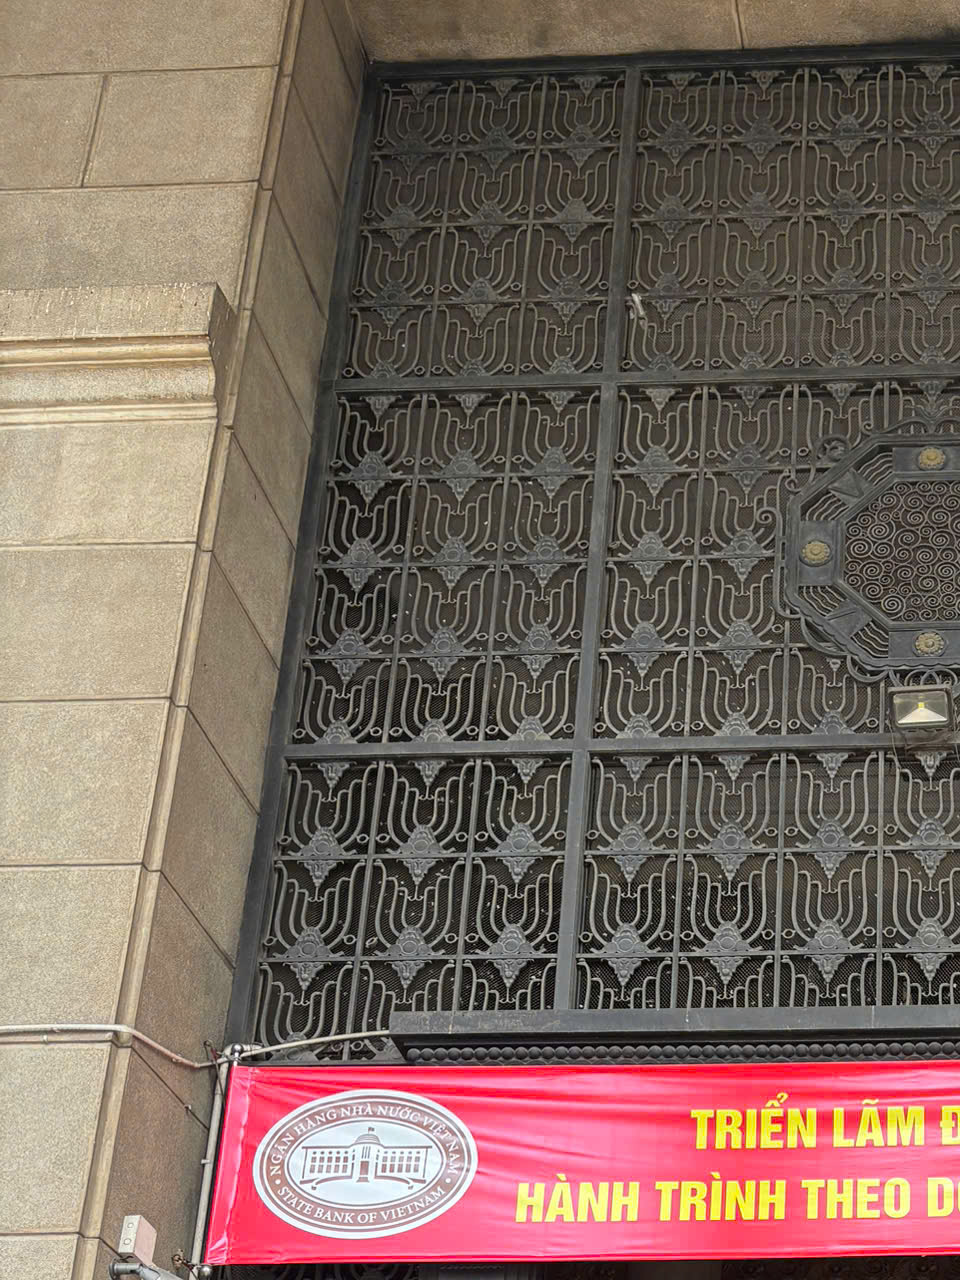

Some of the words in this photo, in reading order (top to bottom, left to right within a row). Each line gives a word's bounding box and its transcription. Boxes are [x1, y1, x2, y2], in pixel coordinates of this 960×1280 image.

[269, 1133, 295, 1176] NGÂN
[293, 1108, 338, 1137] HÀNG
[340, 1103, 376, 1118] NHÀ
[377, 1103, 421, 1122] NƯỚC
[422, 1116, 452, 1141] VIỆT
[446, 1140, 462, 1175] NAM
[691, 1092, 817, 1149] TRIỂN
[832, 1099, 925, 1148] LÃM
[277, 1186, 313, 1215] STATE
[314, 1208, 355, 1224] BANK
[357, 1213, 378, 1224] OF
[381, 1185, 446, 1221] VIETNAM
[515, 1173, 640, 1223] HÀNH
[655, 1171, 787, 1222] TRÌNH
[801, 1178, 911, 1220] THEO
